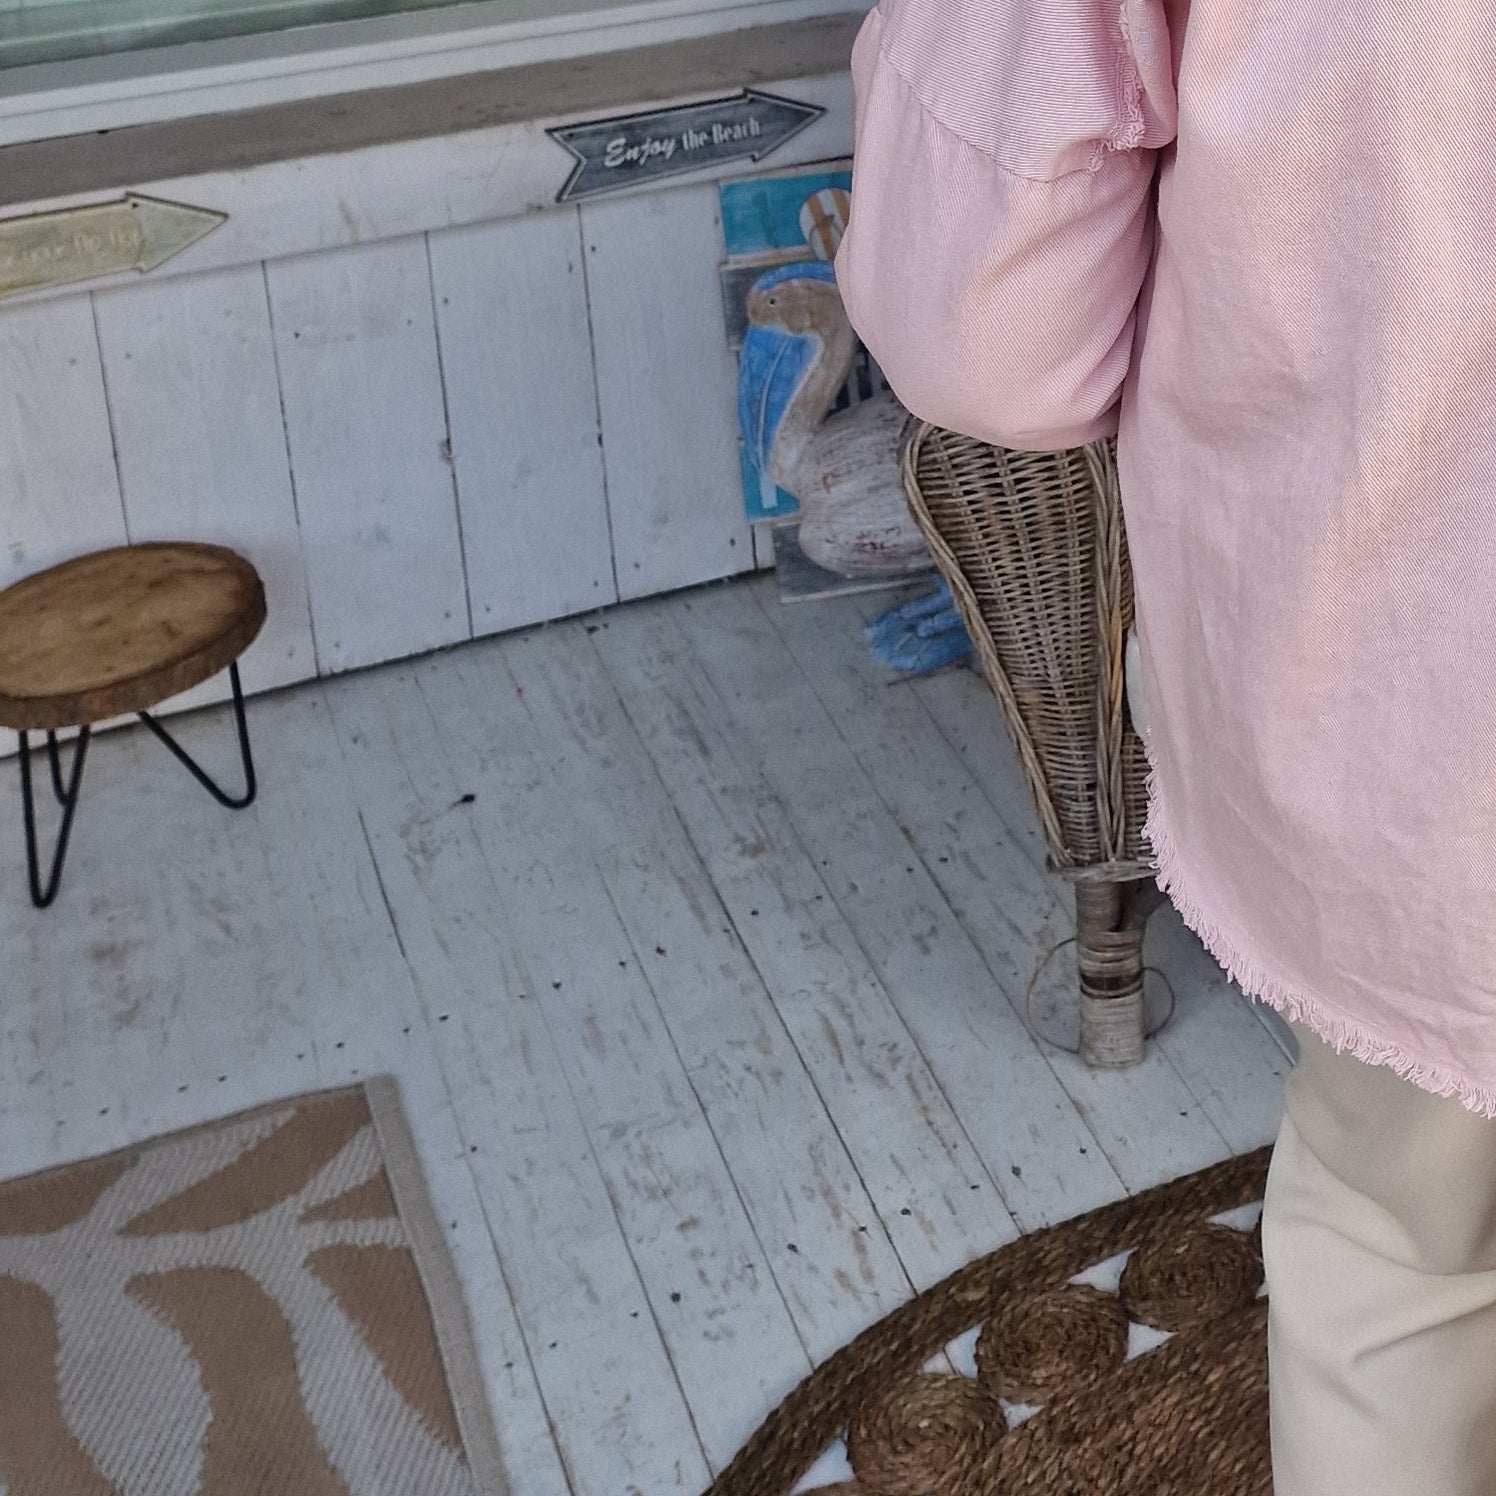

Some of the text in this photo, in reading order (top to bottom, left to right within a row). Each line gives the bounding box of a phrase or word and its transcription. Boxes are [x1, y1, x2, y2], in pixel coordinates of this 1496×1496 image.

[603, 116, 761, 168] Enjoy the Beach
